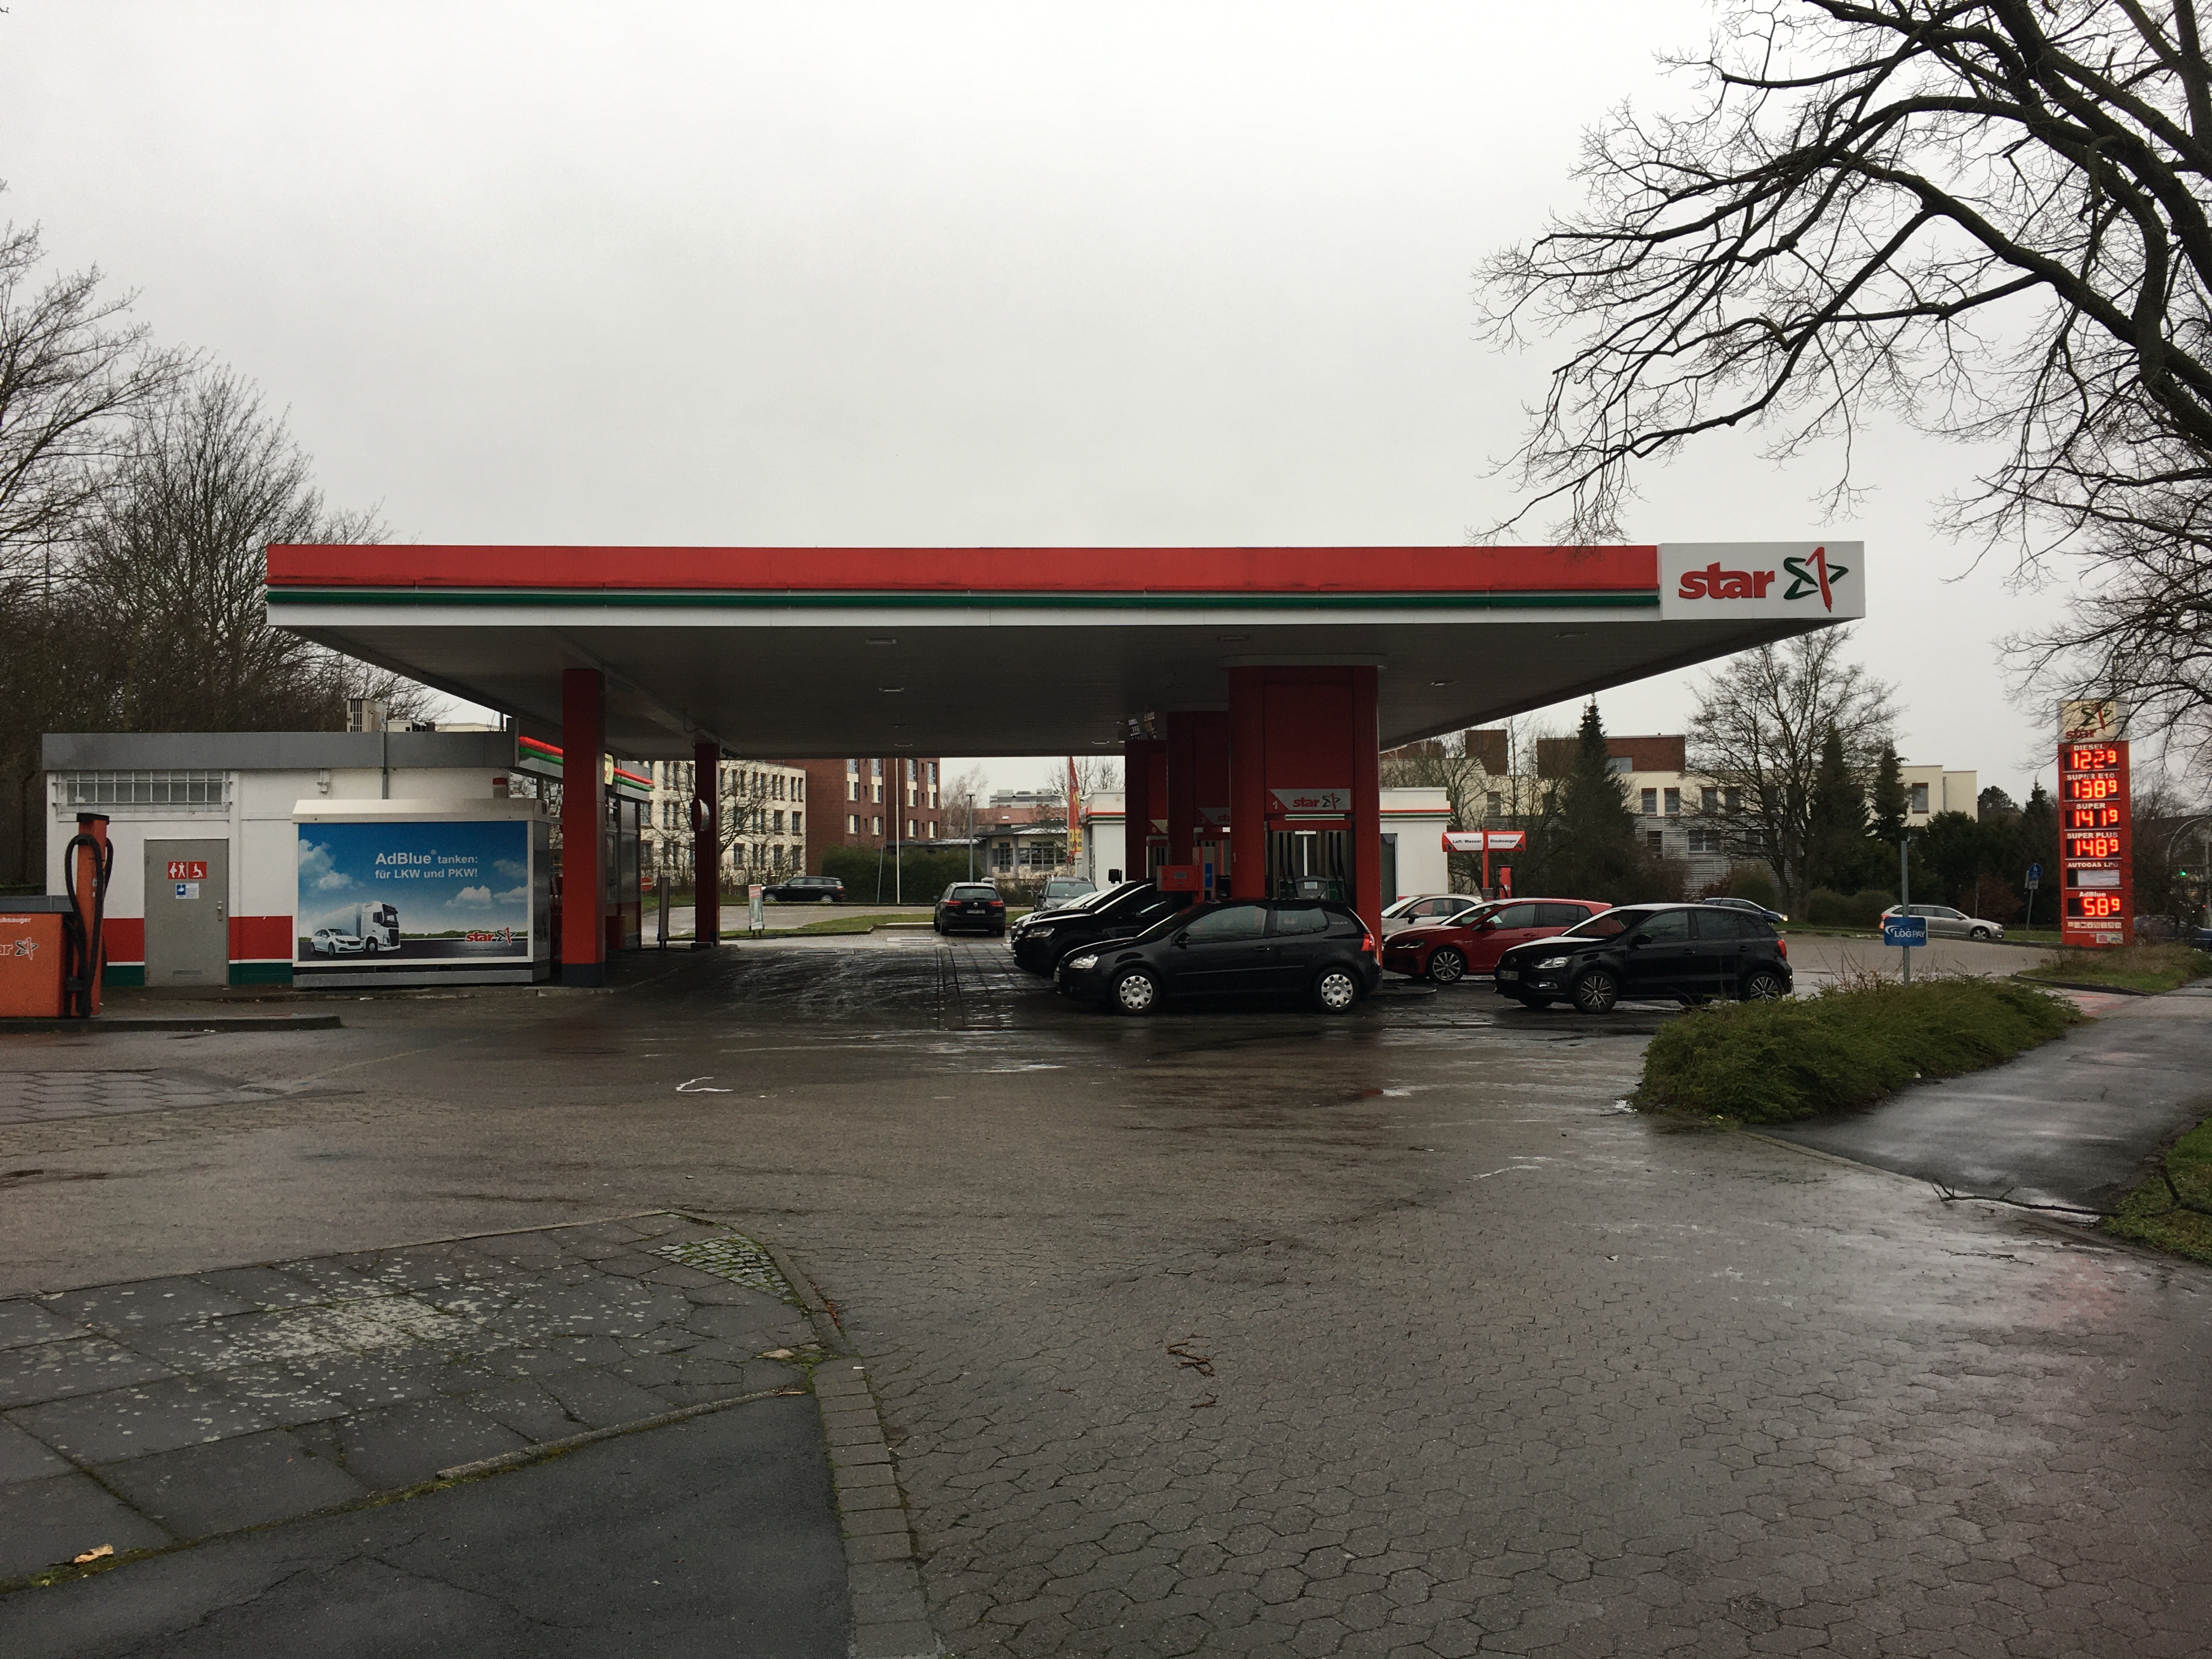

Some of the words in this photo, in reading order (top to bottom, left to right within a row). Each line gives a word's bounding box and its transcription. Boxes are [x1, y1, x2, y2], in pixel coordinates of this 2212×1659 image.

[1679, 562, 1775, 599] star
[2065, 729, 2097, 740] star
[2074, 750, 2117, 769] 1229
[2075, 780, 2118, 798] 1389
[1272, 801, 1278, 809] 1
[1293, 797, 1320, 808] star
[2075, 809, 2118, 827] 1419
[2076, 839, 2119, 856] 1489
[437, 855, 478, 864] tanken:
[375, 870, 391, 879] für
[394, 869, 420, 878] LKW
[424, 868, 444, 878] und
[448, 868, 478, 877] PKW!
[2083, 898, 2120, 916] 589
[465, 932, 495, 943] star
